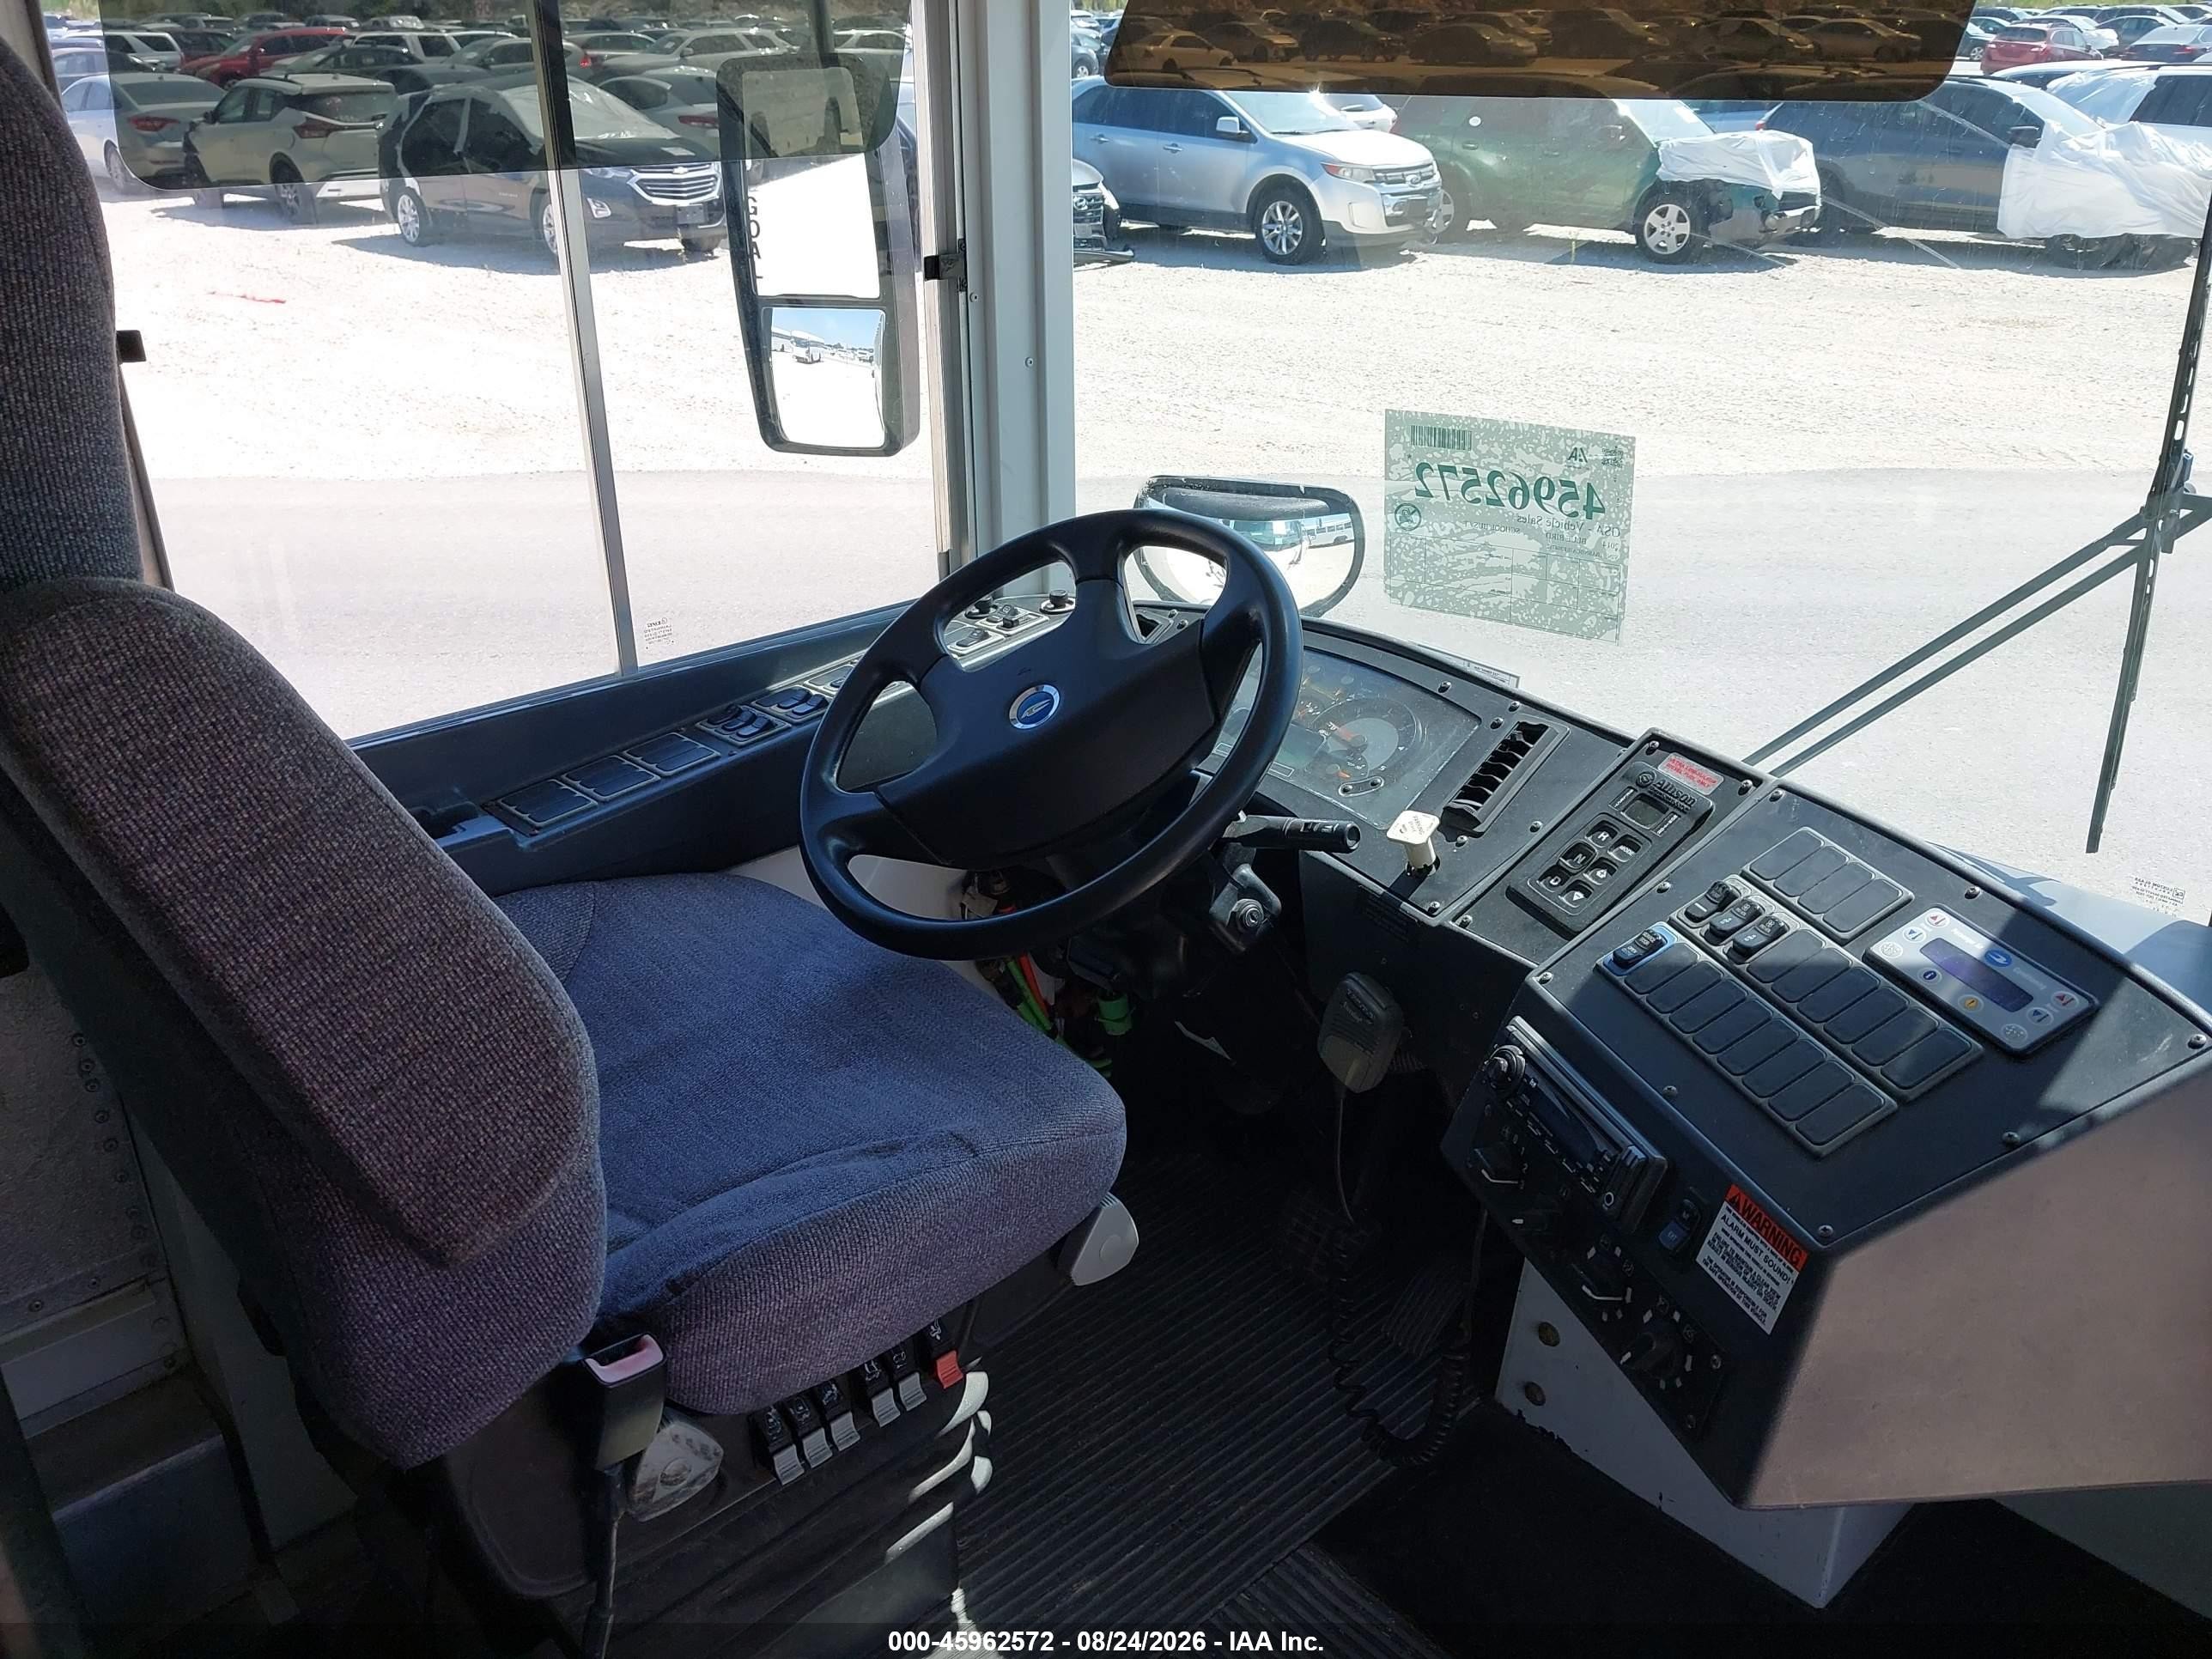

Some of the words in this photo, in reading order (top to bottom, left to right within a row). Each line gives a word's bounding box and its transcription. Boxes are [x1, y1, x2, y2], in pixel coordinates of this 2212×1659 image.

[1652, 779, 1698, 806] Allison
[1597, 830, 1610, 842] R
[1573, 853, 1587, 864] N
[1549, 875, 1562, 885] D
[1741, 1199, 1802, 1267] WARNING
[1721, 1212, 1745, 1239] ALARM
[1743, 1235, 1763, 1257] MUST
[1762, 1254, 1790, 1285] SOUND!
